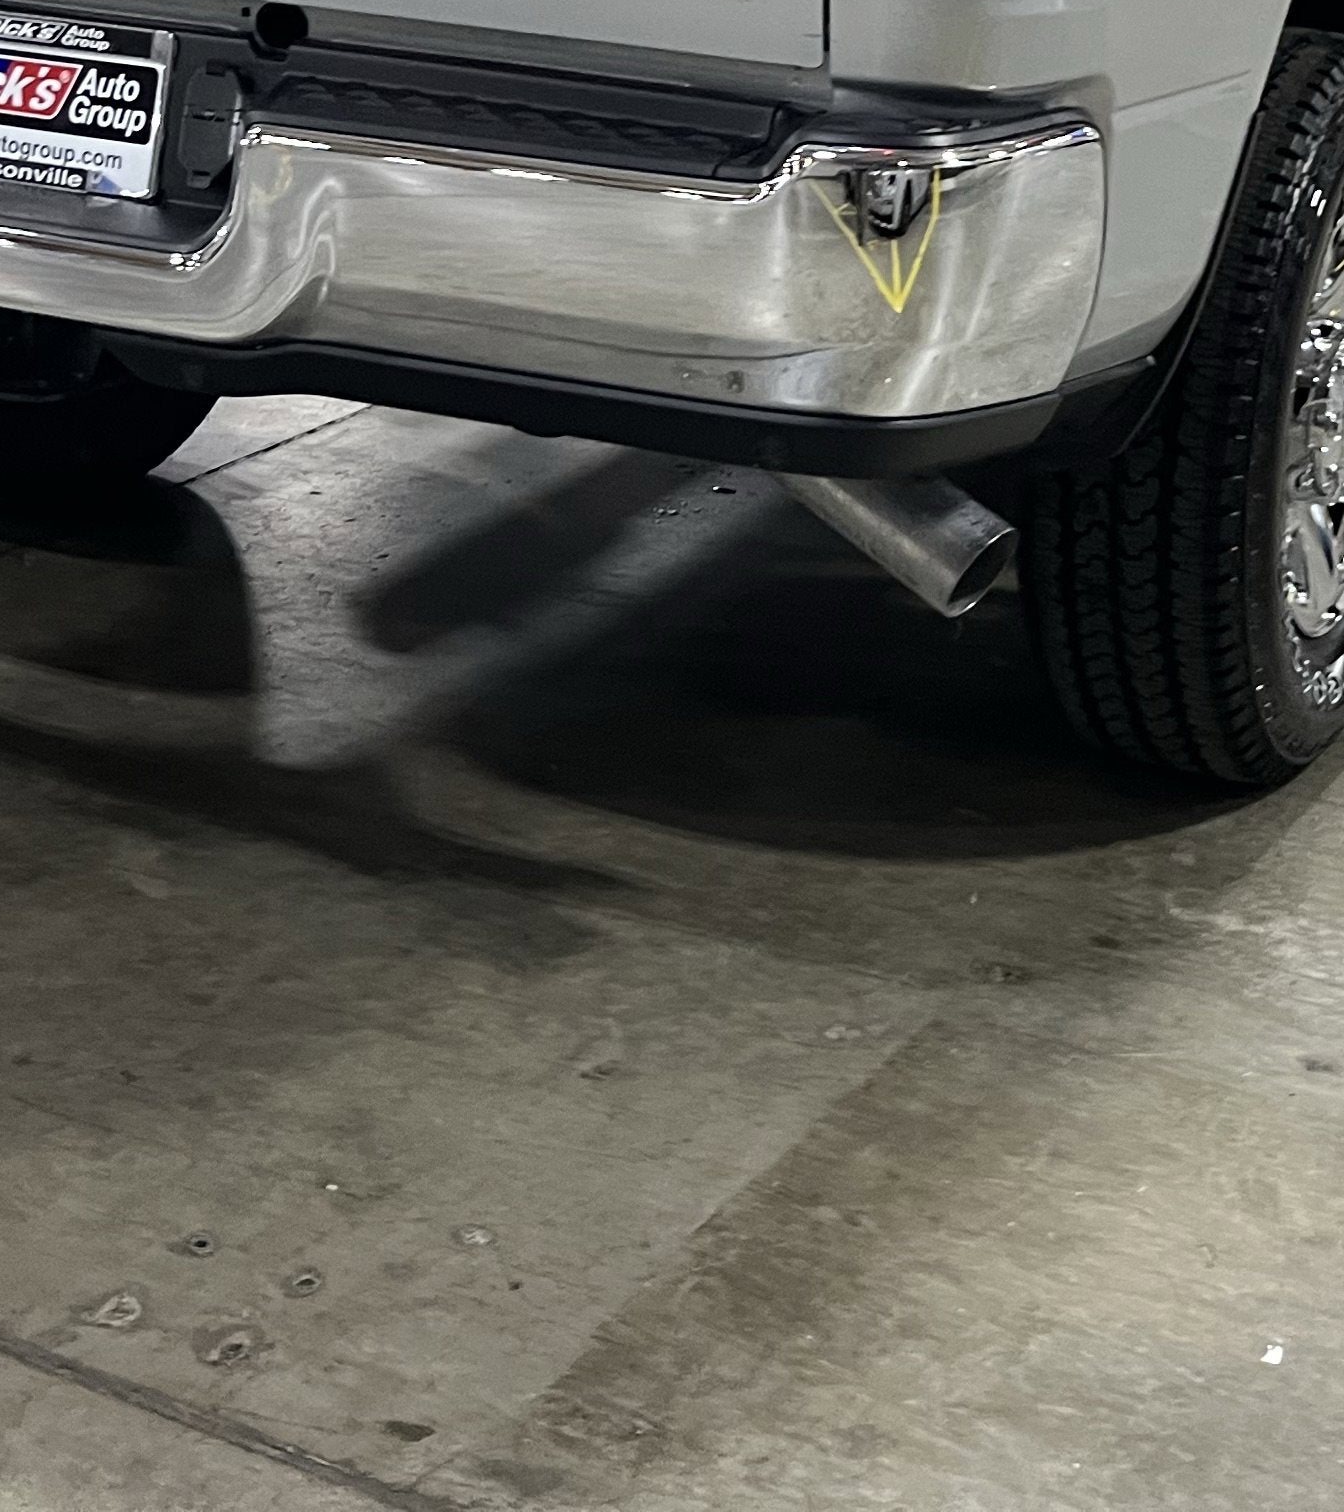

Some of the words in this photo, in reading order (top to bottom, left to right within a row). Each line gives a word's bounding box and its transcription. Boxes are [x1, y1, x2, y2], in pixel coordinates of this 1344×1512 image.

[61, 35, 110, 51] Group
[67, 25, 105, 40] Auto
[76, 68, 140, 103] Auto
[68, 95, 147, 137] Group
